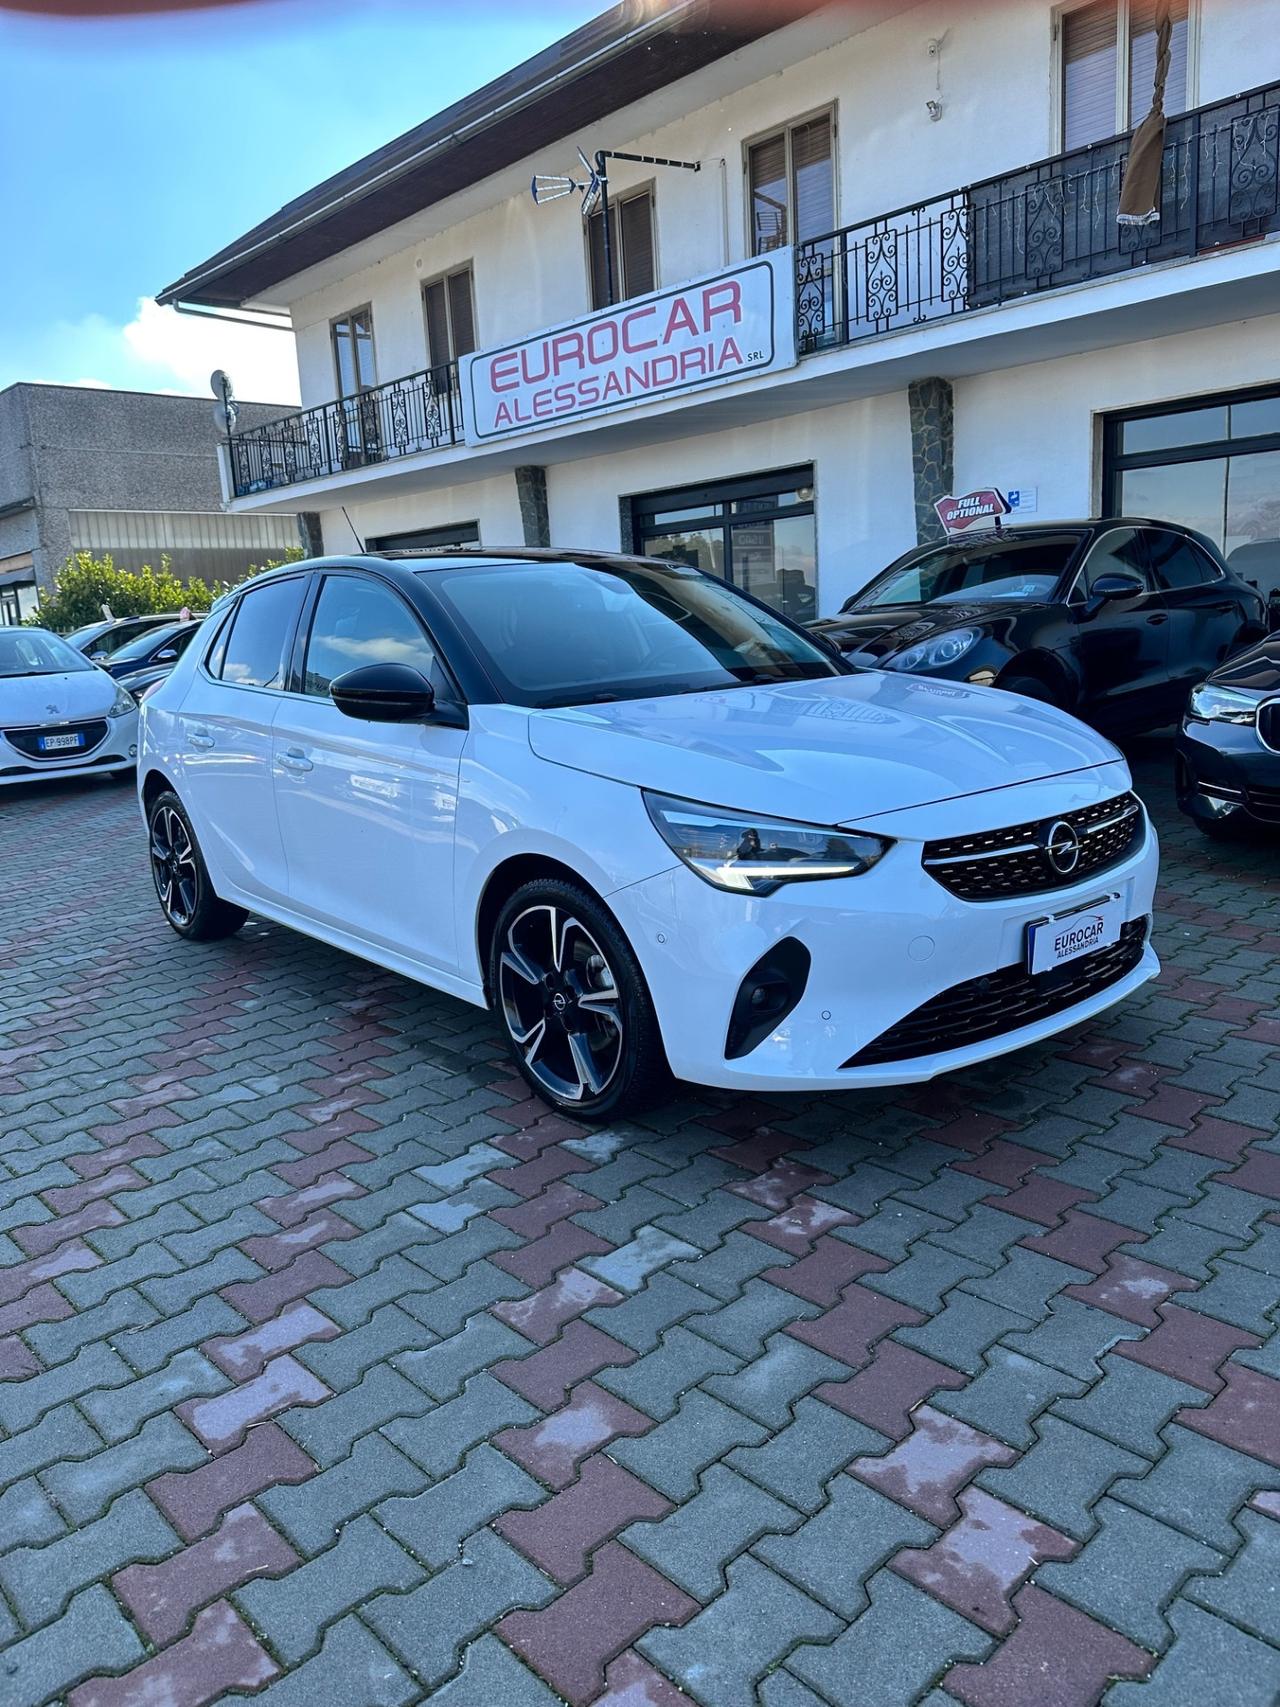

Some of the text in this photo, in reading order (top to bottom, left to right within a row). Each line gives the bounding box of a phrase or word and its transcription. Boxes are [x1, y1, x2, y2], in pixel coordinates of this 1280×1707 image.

[489, 280, 742, 393] EUROCAR
[494, 337, 764, 428] ALESSANDRIA SRL
[946, 503, 994, 521] OPTIONAL
[958, 497, 980, 509] FULL
[1054, 922, 1104, 951] EUROCAR
[1056, 937, 1099, 959] ALESSANDRIA
